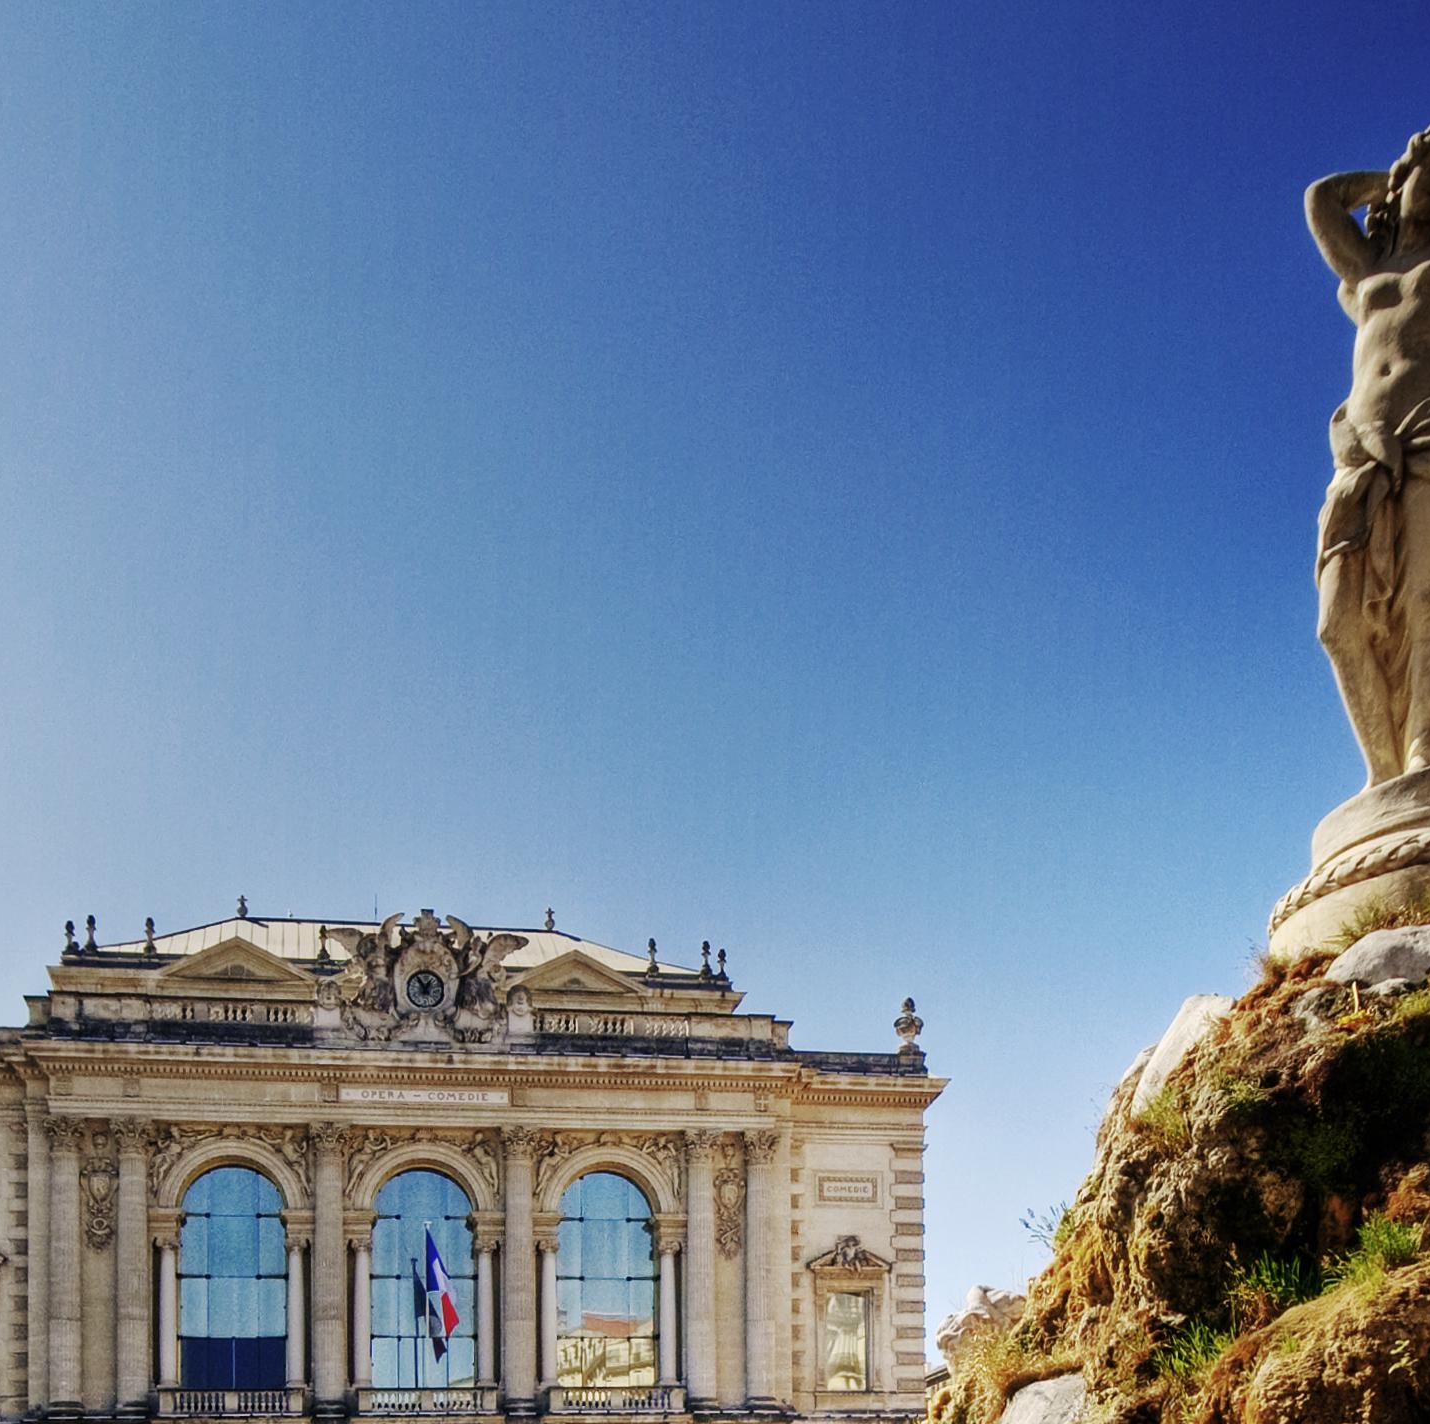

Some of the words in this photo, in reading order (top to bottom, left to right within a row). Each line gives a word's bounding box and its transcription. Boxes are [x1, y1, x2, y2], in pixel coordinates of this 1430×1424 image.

[361, 1090, 405, 1100] OPERA
[427, 1092, 489, 1101] COMEDIE
[827, 1185, 869, 1193] COMEDIE
